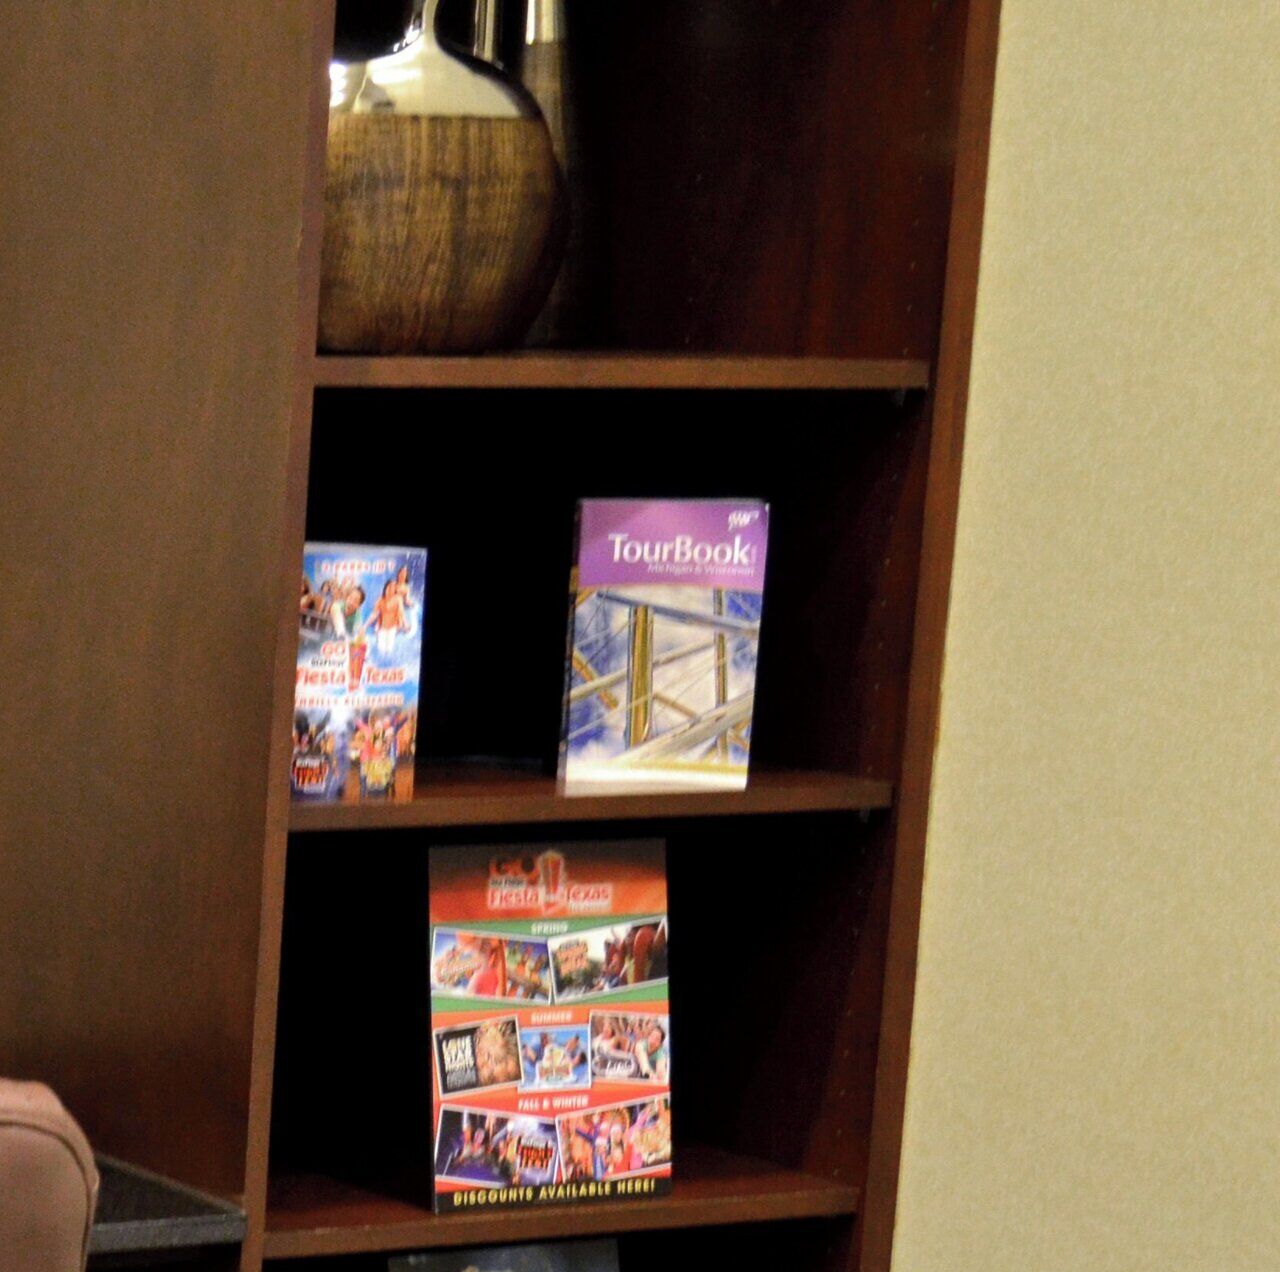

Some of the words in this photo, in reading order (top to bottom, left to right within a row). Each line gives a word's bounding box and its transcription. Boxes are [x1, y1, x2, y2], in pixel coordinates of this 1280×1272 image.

[608, 533, 750, 566] TourBook
[366, 667, 406, 684] Texas
[518, 1097, 539, 1111] FALL
[552, 1094, 589, 1109] WINTER
[453, 1185, 533, 1207] DISCOUNTS
[539, 1180, 611, 1200] AVAILABLE
[617, 1177, 655, 1195] HERE!
